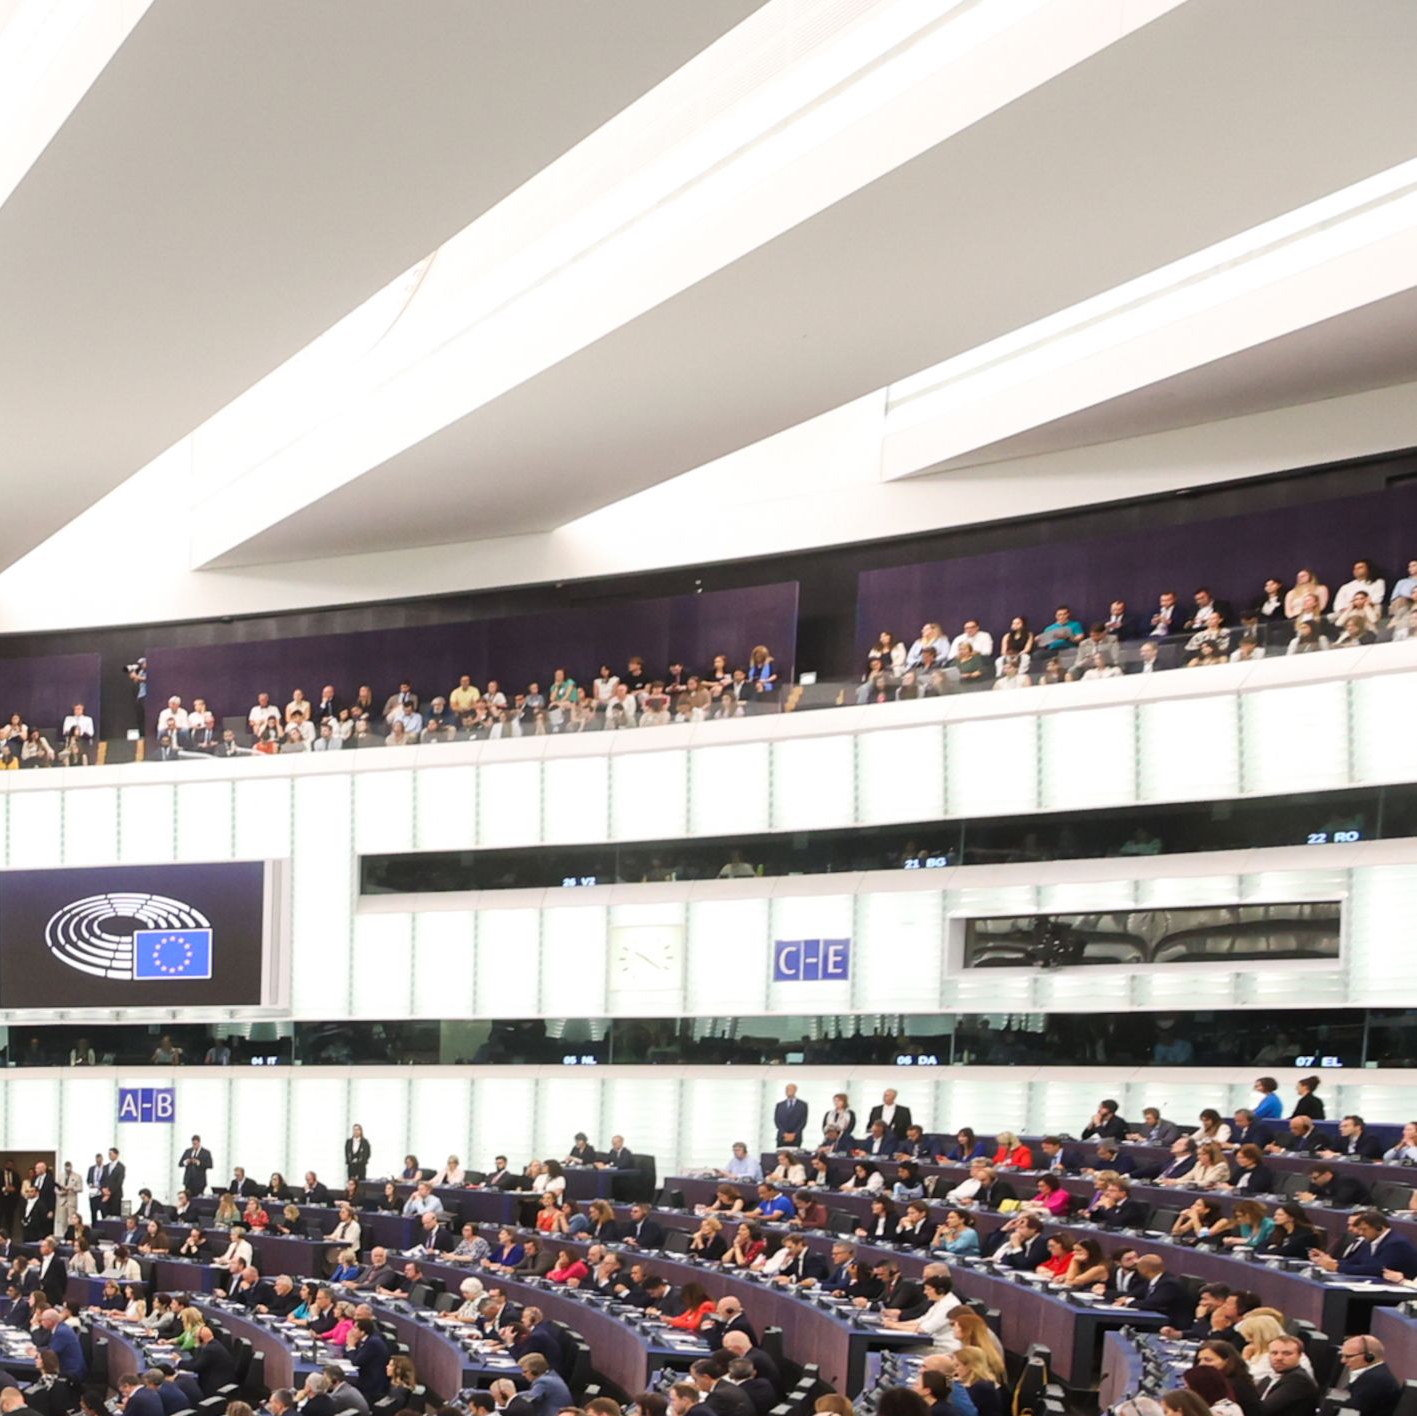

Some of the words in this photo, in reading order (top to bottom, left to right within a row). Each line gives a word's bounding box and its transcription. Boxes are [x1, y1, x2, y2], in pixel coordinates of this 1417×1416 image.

[1307, 833, 1327, 844] 22
[1334, 831, 1359, 842] RO
[904, 859, 920, 869] 21
[926, 857, 946, 868] BG
[779, 944, 844, 975] C-E
[251, 1057, 264, 1065] 04
[267, 1056, 277, 1065] IT
[581, 1055, 597, 1065] NL
[918, 1055, 937, 1065] DA
[1295, 1056, 1314, 1066] 07
[1322, 1056, 1343, 1066] EL
[120, 1093, 173, 1118] A-B
